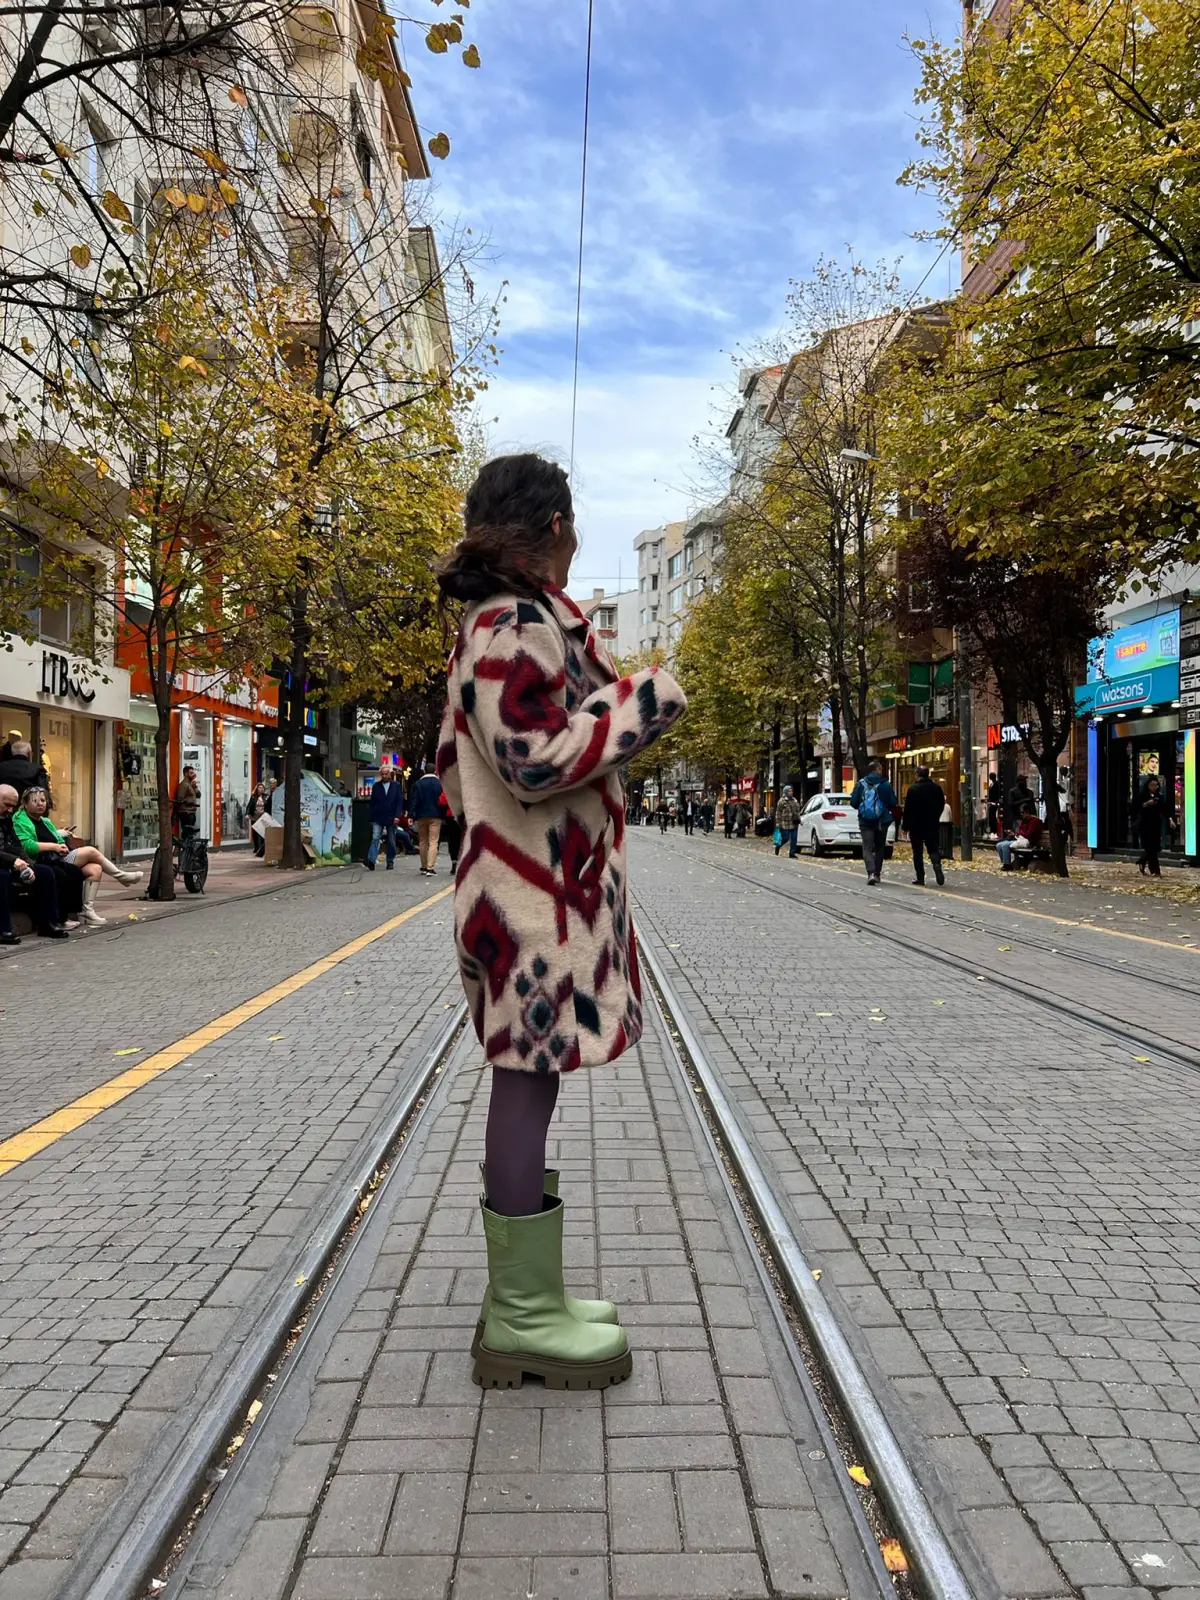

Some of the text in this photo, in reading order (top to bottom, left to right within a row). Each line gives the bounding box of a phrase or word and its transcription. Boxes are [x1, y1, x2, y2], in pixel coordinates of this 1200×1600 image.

[42, 650, 69, 697] LTB
[1101, 682, 1144, 702] watsons
[48, 719, 69, 736] LTB
[988, 724, 1000, 748] IN
